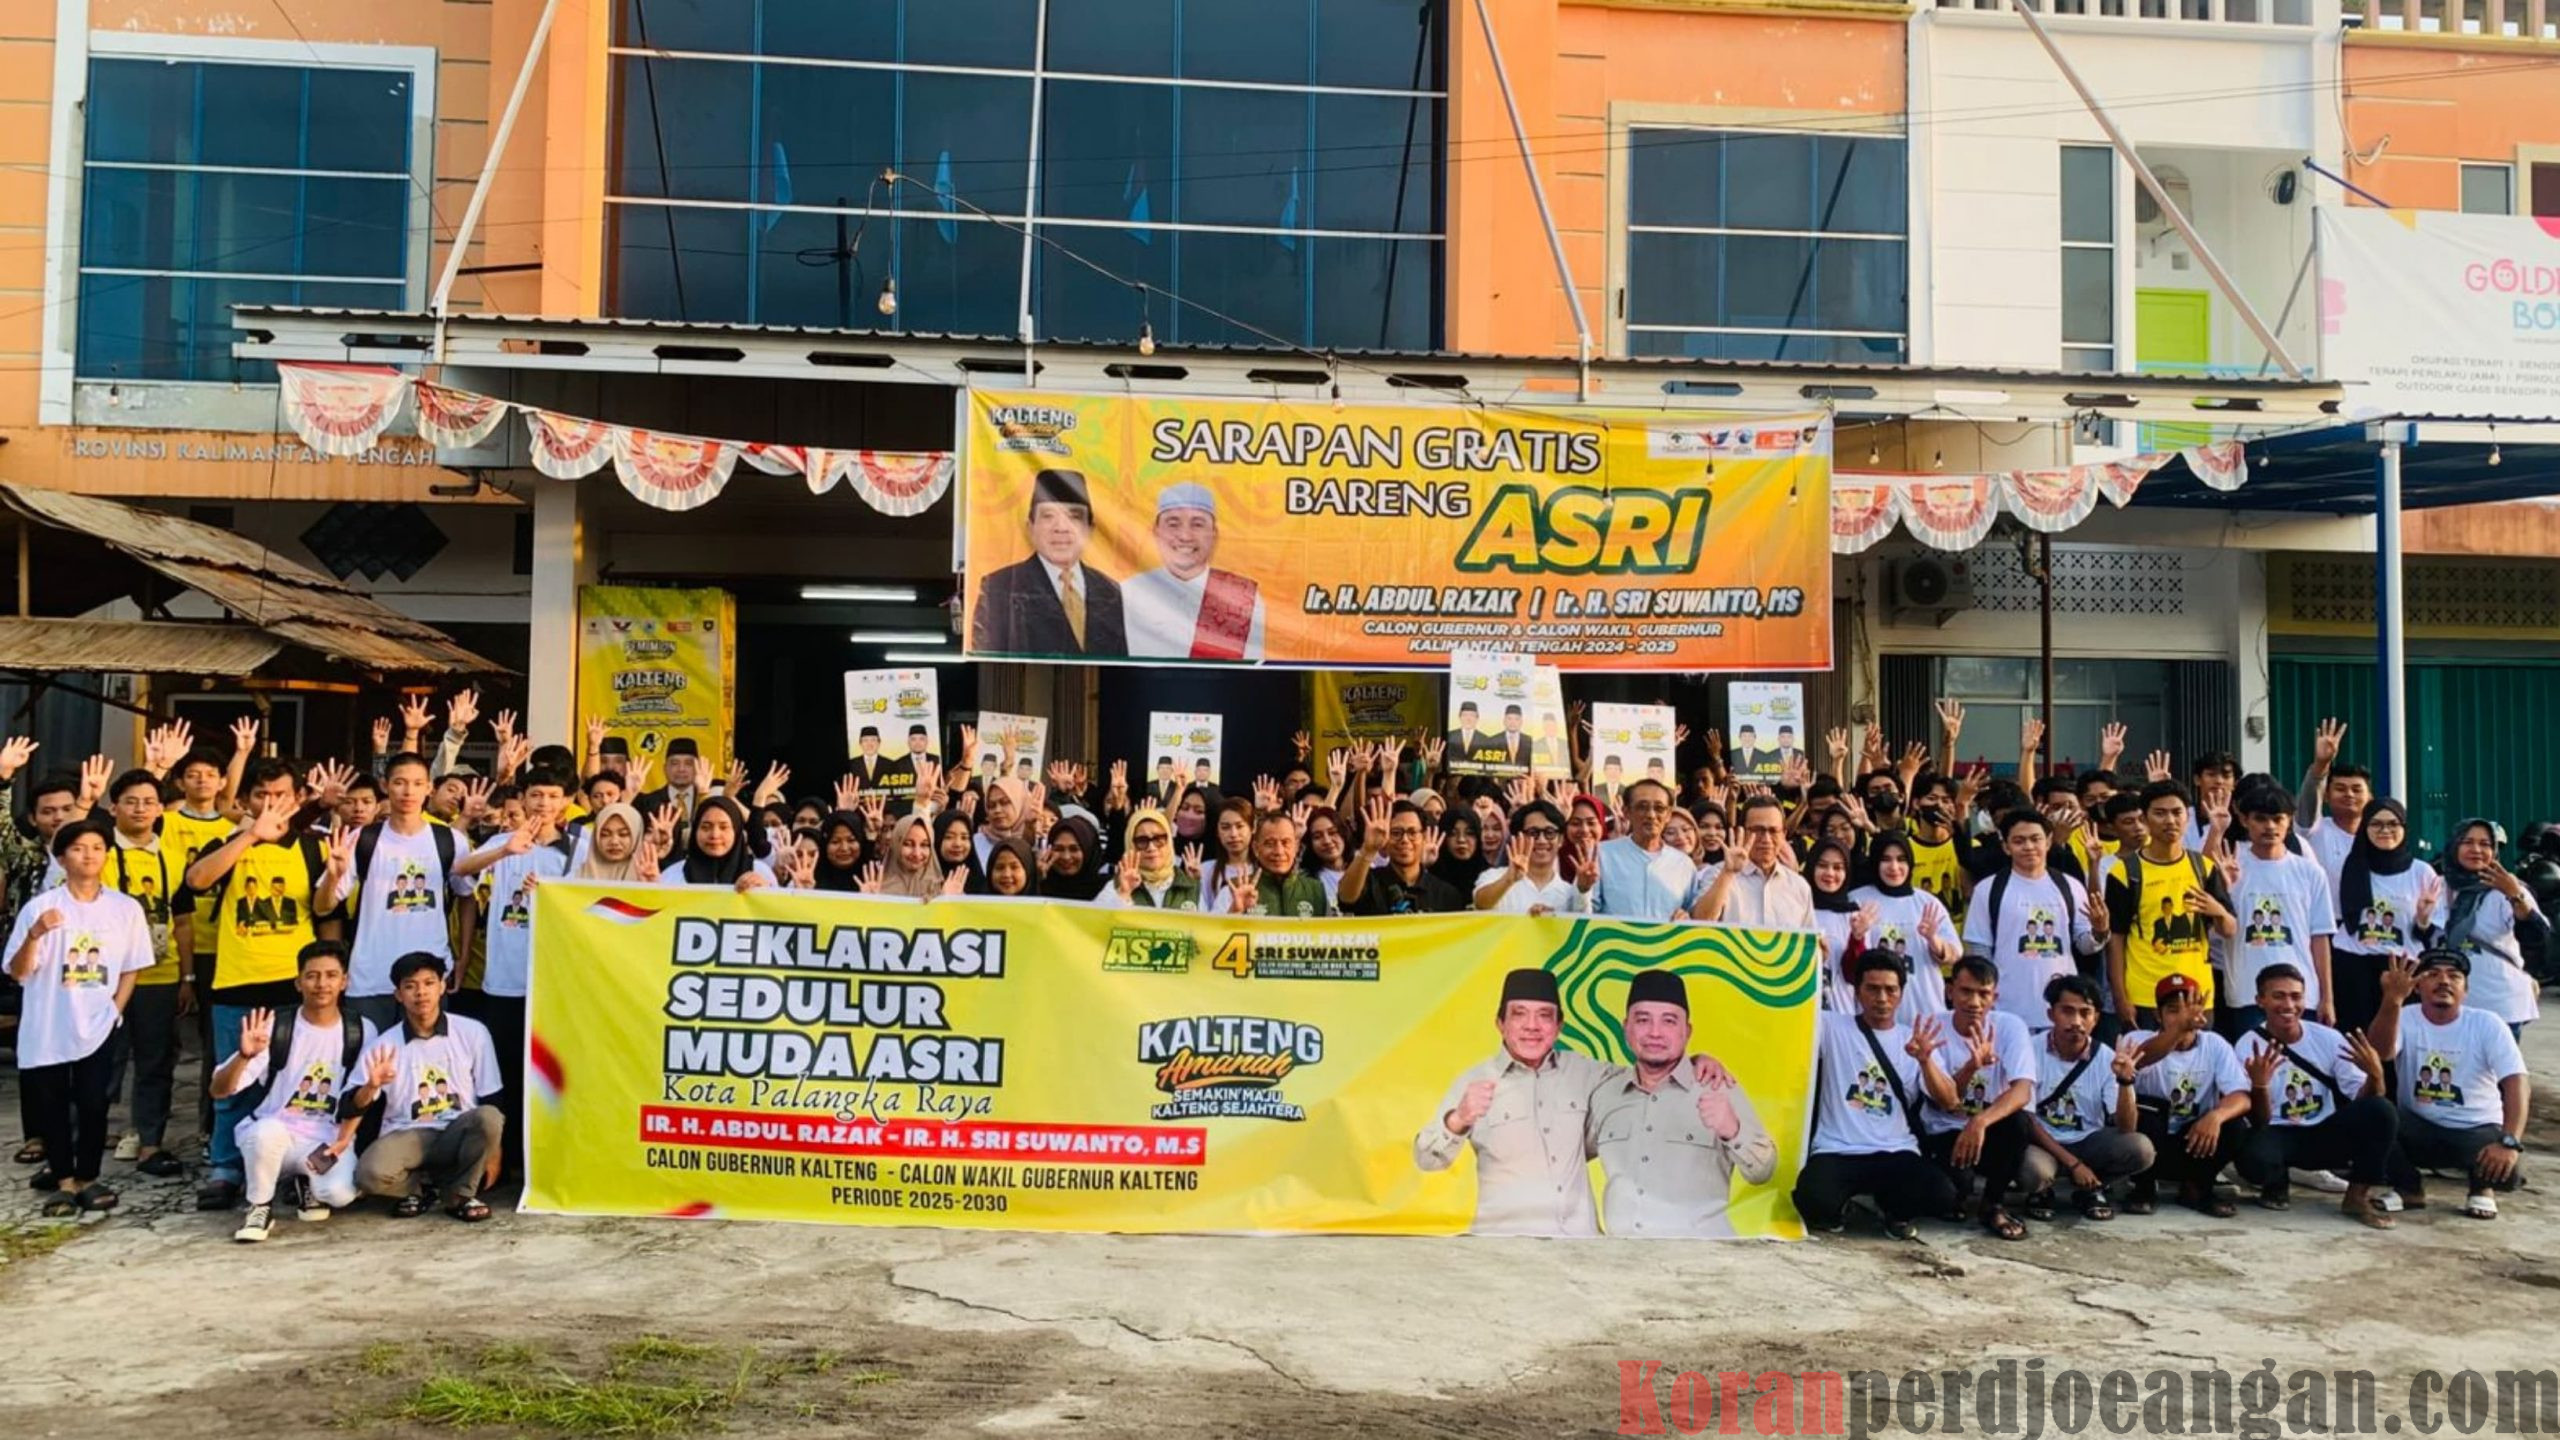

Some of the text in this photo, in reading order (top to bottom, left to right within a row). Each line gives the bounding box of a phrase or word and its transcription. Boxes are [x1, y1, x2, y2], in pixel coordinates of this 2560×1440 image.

[2513, 301, 2560, 329] BO
[990, 407, 1077, 430] KALTENG
[75, 439, 435, 466] ROVINSI KALIMANTAN ENGAH
[1151, 419, 1600, 473] SARAPAN GRATIS
[1287, 478, 1470, 518] BARENG
[1455, 485, 1711, 575] ASRI
[1304, 584, 1330, 612] Ir.
[1335, 585, 1358, 613] H.
[1362, 586, 1436, 614] ABDUL
[1440, 587, 1521, 616] RAZAK
[1554, 589, 1581, 616] Ir.
[1585, 590, 1608, 616] H.
[1613, 589, 1651, 617] SRI
[1652, 588, 1764, 619] SUWANTO,
[1766, 587, 1804, 616] MS
[1364, 621, 1723, 637] CALON GUBERNUR & CALON WAKIL GUBERNUR
[1409, 638, 1518, 653] KALIMANTAN
[1519, 639, 1584, 653] TENGAH
[1585, 640, 1624, 653] 2024
[1638, 640, 1677, 653] 2029
[613, 671, 687, 690] KALTENG
[1343, 685, 1406, 703] KALTENG
[1472, 749, 1507, 761] ASRI
[879, 773, 914, 786] ASRI
[672, 916, 1007, 978] DEKLARASI
[1255, 947, 1379, 959] SRI SUWANTO
[1256, 933, 1379, 946] ABDUL RAZAK
[1213, 932, 1254, 978] 4
[664, 971, 951, 1030] SEDULUR
[1138, 1015, 1323, 1065] KALTENG
[664, 1025, 1003, 1087] MUDA ASRI
[1158, 1048, 1292, 1088] Amanah
[664, 1072, 992, 1125] Kota Palangka Raya
[1173, 1088, 1283, 1103] SEMAKIN MAJU
[1152, 1101, 1305, 1119] KALTENG SEJAHTERA
[646, 1114, 677, 1133] IR.
[682, 1117, 705, 1135] H.
[710, 1119, 793, 1141] ABDUL
[797, 1124, 883, 1145] RAZAK
[904, 1128, 934, 1147] IR.
[941, 1129, 966, 1148] H.
[971, 1130, 1010, 1149] SRI
[1014, 1132, 1150, 1156] SUWANTO,
[1154, 1135, 1201, 1155] M.S
[646, 1148, 701, 1170] CALON
[706, 1151, 796, 1177] GUBERNUR
[801, 1158, 877, 1181] KALTENG
[900, 1163, 957, 1186] CALON
[962, 1165, 1017, 1188] WAKIL
[1021, 1167, 1114, 1190] GUBERNUR
[1120, 1169, 1198, 1190] KALTENG
[832, 1186, 1008, 1212] PERIODE 2025-2030
